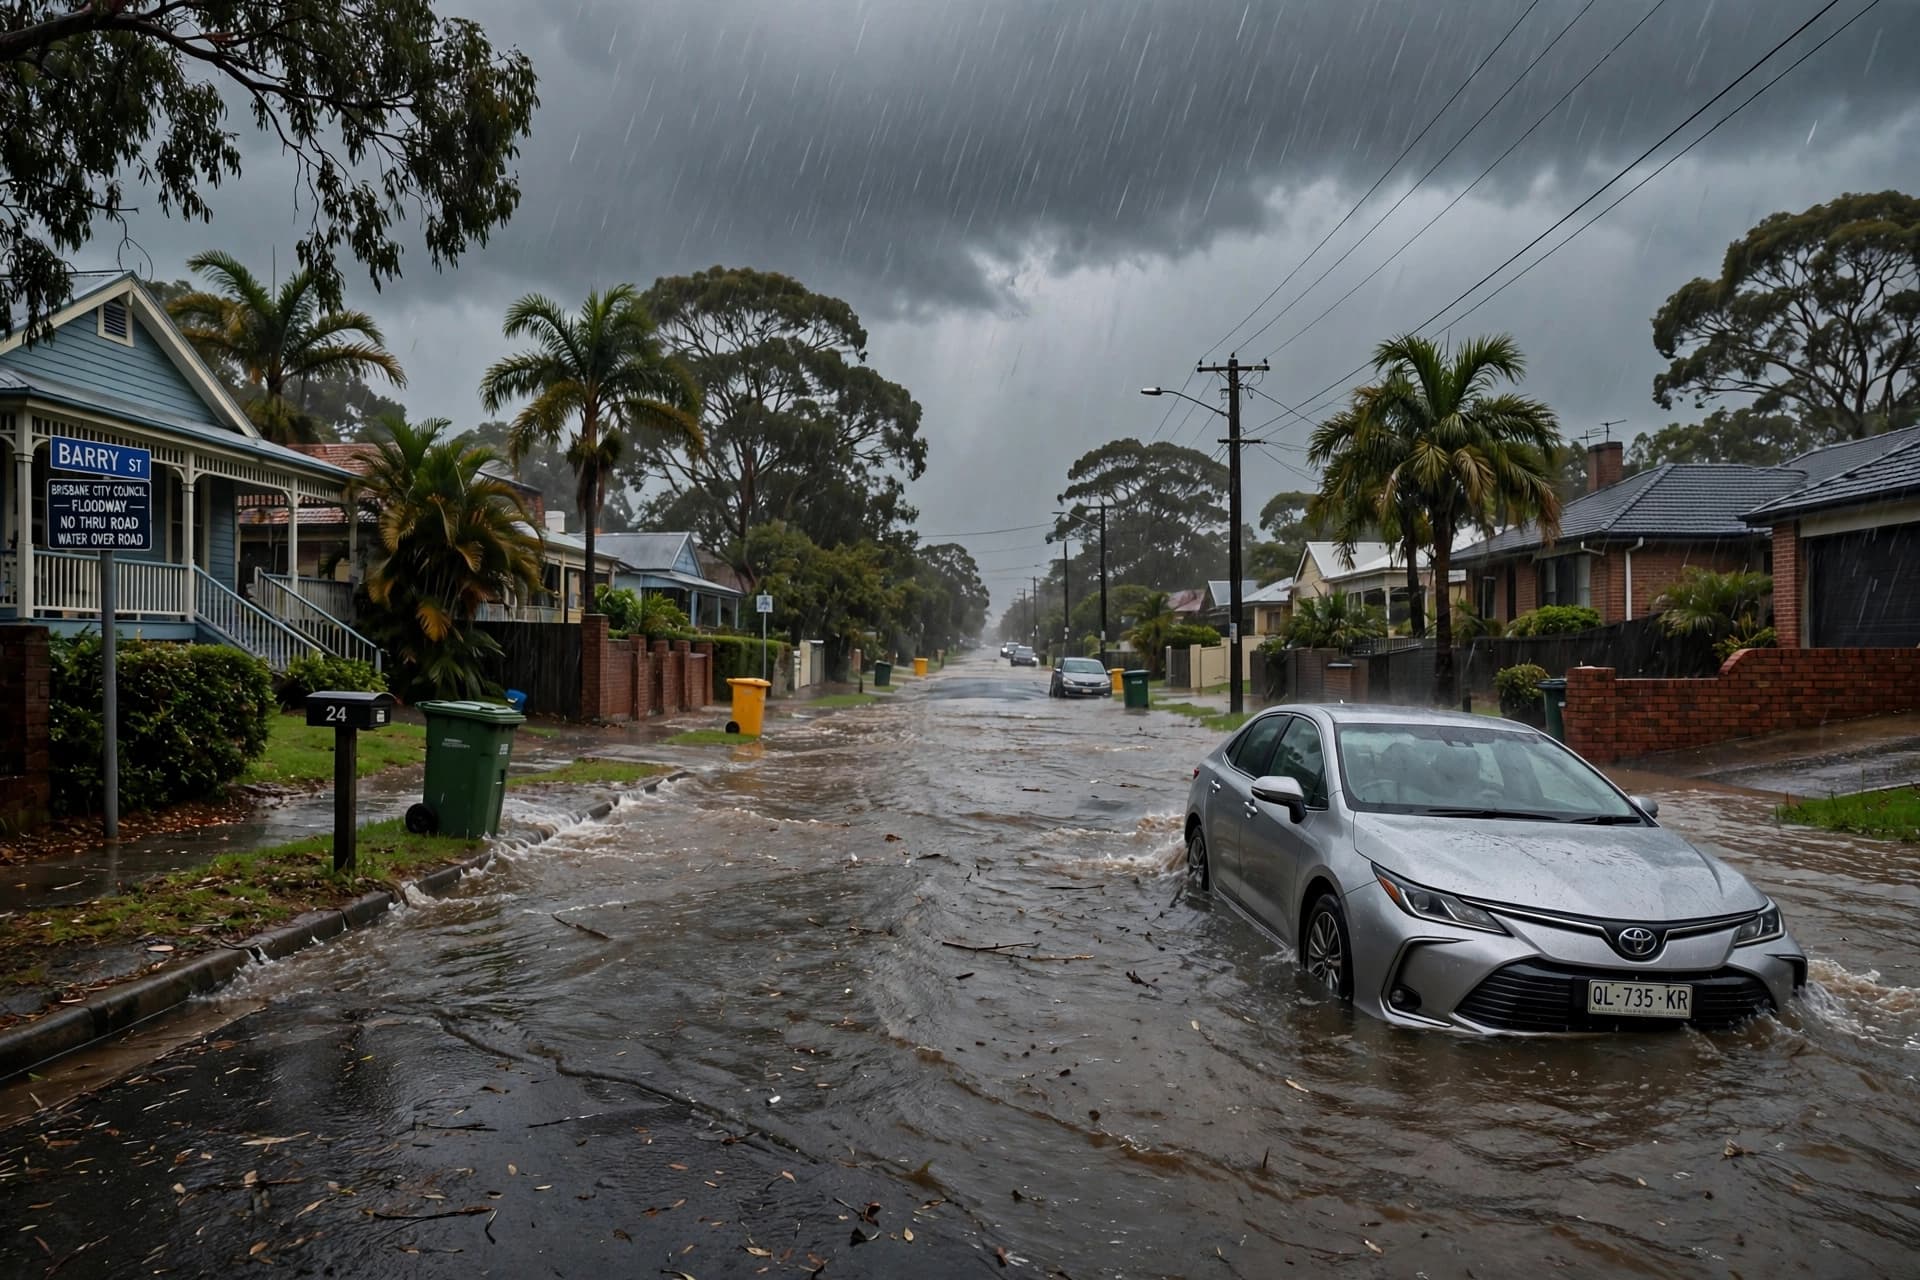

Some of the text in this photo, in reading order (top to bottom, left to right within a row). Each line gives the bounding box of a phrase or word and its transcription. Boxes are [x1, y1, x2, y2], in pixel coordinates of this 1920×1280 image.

[58, 443, 142, 472] BARRY ST
[51, 484, 147, 497] BRISBANE CITY COUNCIL
[72, 500, 127, 513] FLOODWAY
[60, 515, 139, 530] NO THRU ROAD
[57, 532, 144, 545] WATER OVER ROAD
[326, 705, 347, 722] 24
